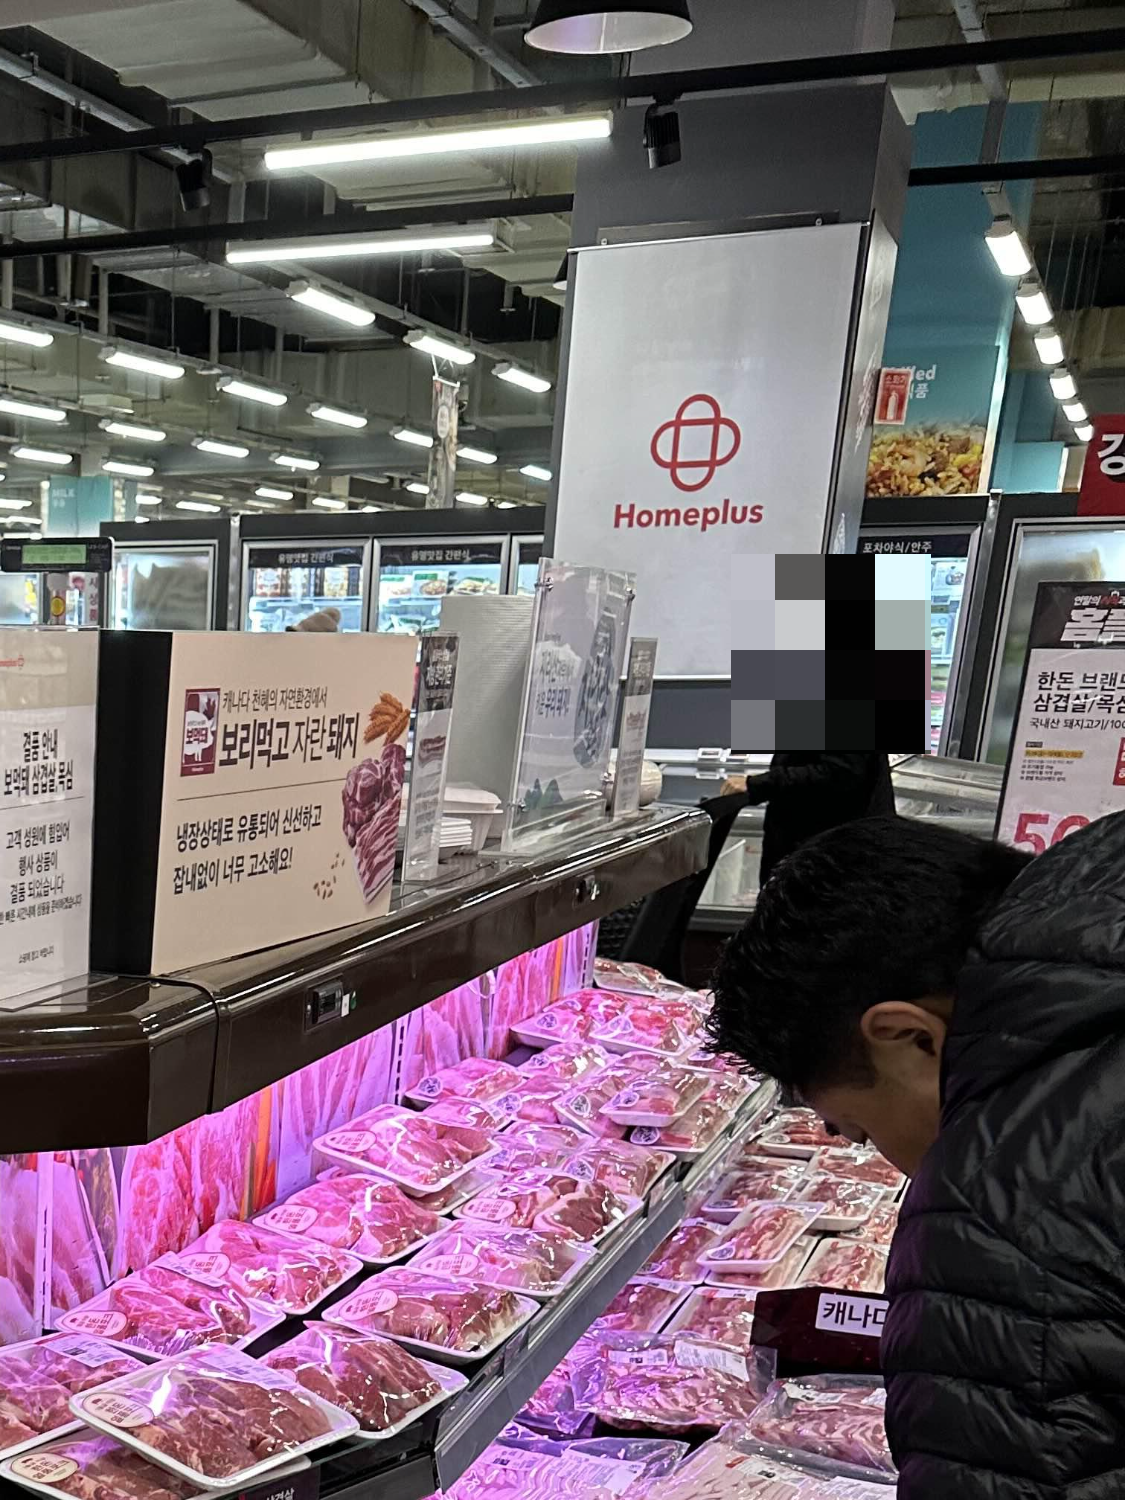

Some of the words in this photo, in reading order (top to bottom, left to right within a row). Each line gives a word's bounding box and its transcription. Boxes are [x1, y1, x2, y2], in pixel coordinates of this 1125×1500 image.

[614, 498, 764, 532] Homeplus
[863, 541, 932, 553] 포차야식/안주
[1038, 672, 1074, 691] 한돈
[223, 689, 250, 713] 캐나다
[252, 687, 277, 711] 천혜의
[279, 686, 327, 711] 자연환경에서
[1030, 717, 1061, 730] 국내산
[23, 731, 40, 763] 결품
[42, 728, 58, 760] 안내
[219, 718, 290, 769] 보리먹고
[292, 715, 326, 763] 자란
[326, 712, 360, 760] 돼지
[4, 765, 30, 797] 보먹돼
[6, 829, 22, 850] 고객
[24, 824, 47, 848] 성원에
[48, 821, 70, 844] 힘입어
[177, 817, 233, 852] 냉장상태로
[237, 809, 280, 843] 유통되어
[282, 804, 322, 835] 신선하고
[19, 854, 34, 877] 행사
[36, 849, 58, 873] 상품이
[173, 858, 220, 895] 잡내없이
[223, 855, 245, 884] 너무
[247, 846, 294, 877] 고소해요!
[10, 882, 26, 904] 결품
[28, 873, 65, 899] 되었습니다
